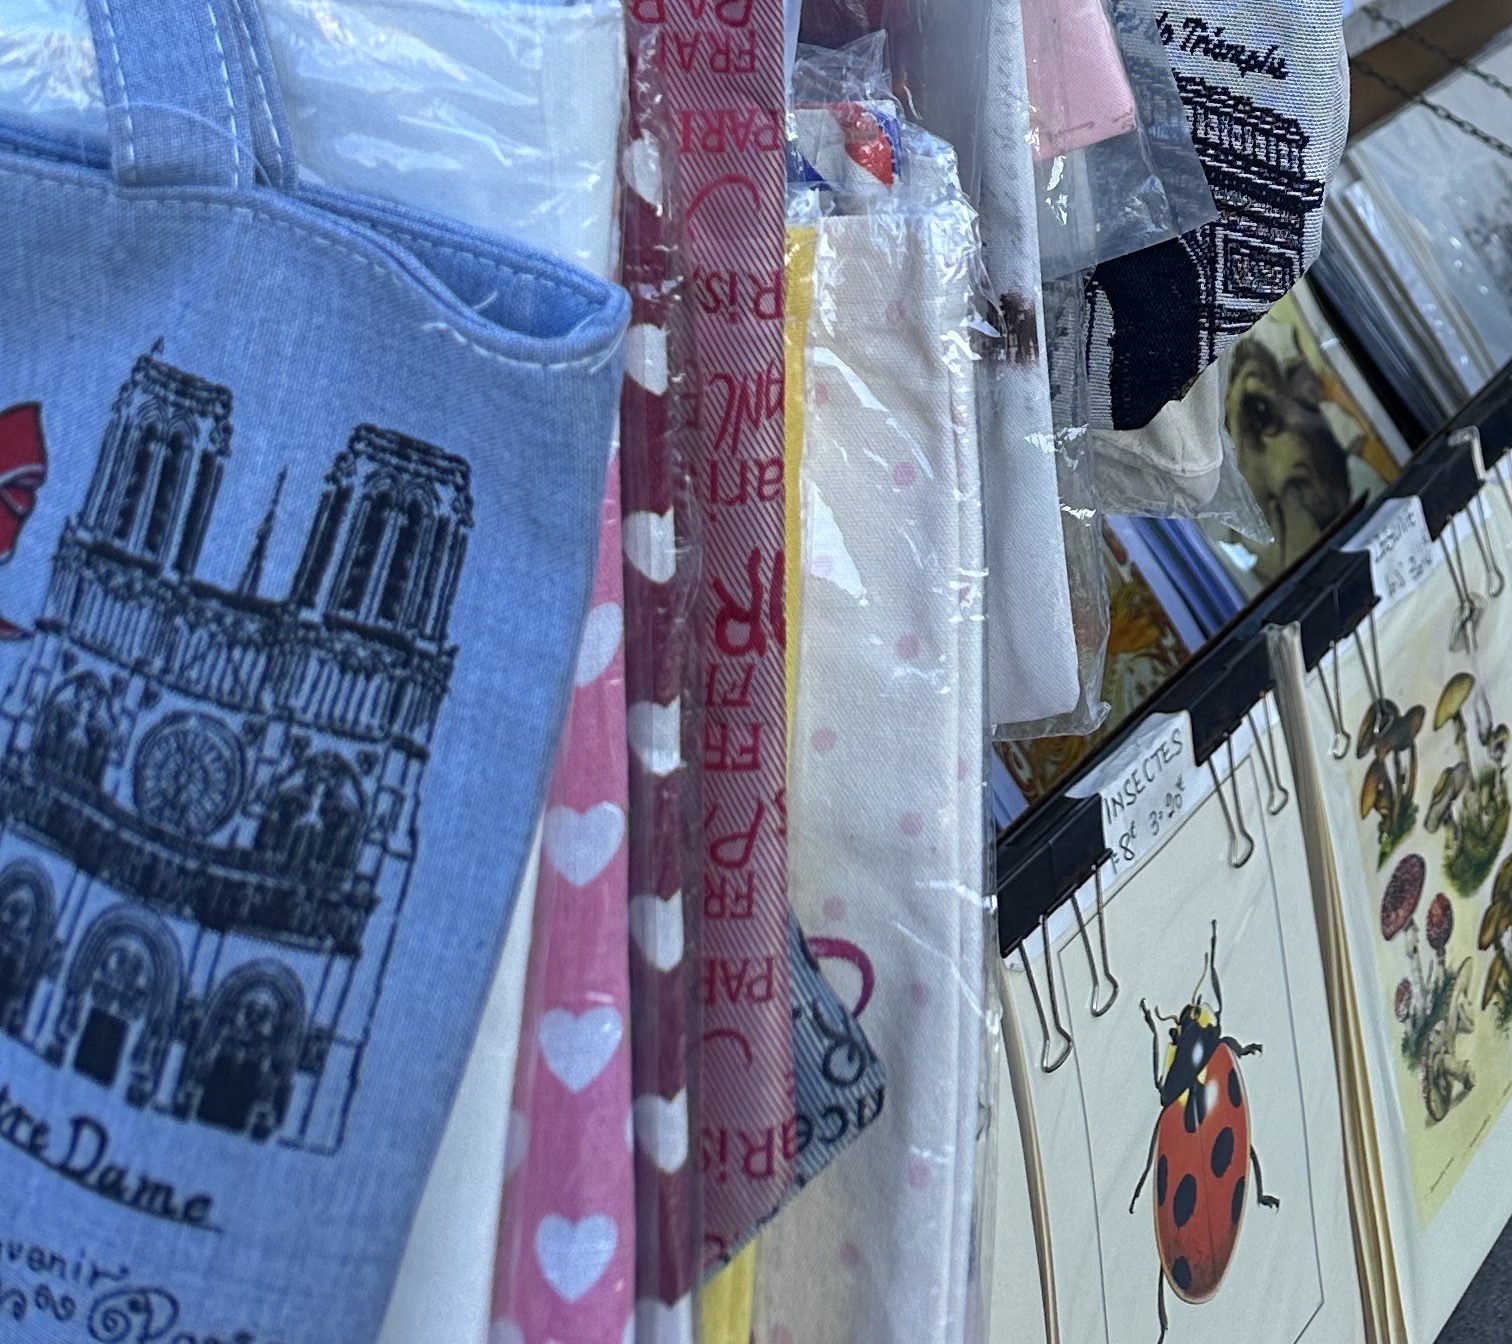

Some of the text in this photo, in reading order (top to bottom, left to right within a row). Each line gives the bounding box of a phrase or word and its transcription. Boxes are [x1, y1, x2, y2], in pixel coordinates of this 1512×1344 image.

[1103, 727, 1184, 825] INSECTES
[58, 1115, 213, 1224] Dame
[0, 1240, 129, 1288] venir
